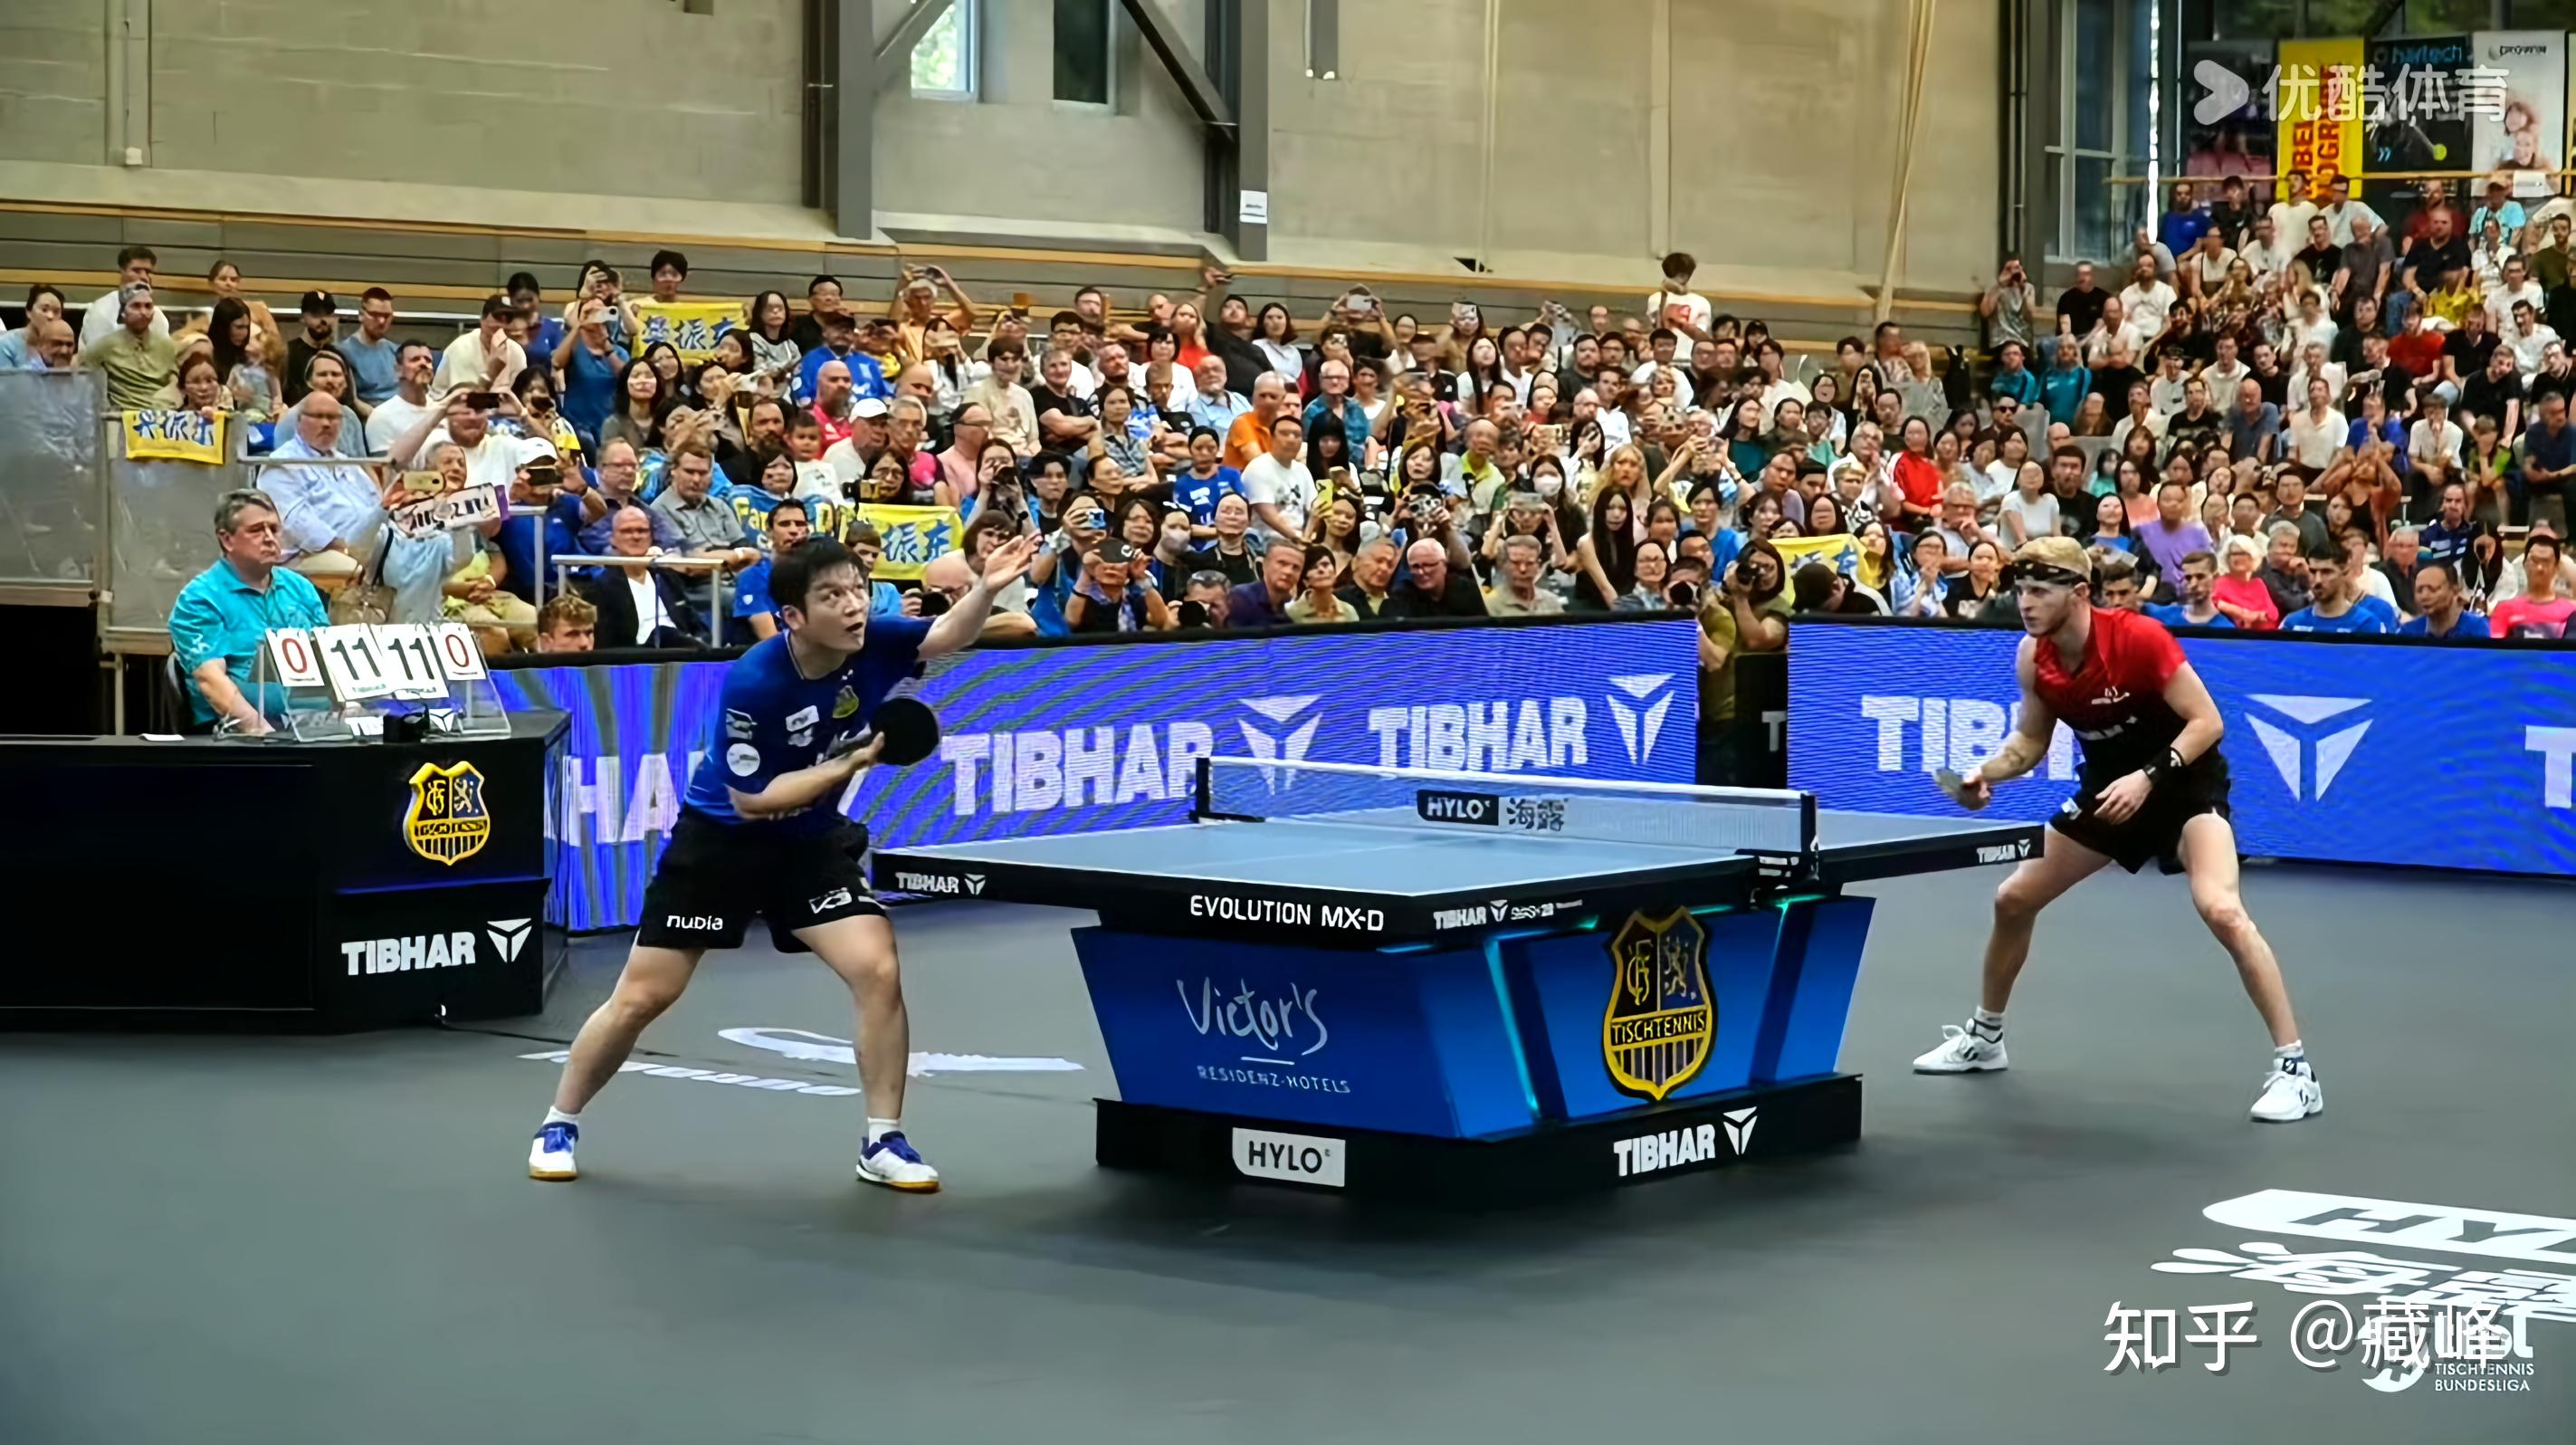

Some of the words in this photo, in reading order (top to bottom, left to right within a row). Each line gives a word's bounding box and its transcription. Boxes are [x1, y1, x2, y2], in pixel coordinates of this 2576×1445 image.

[281, 637, 308, 674] 0
[329, 636, 382, 680] 11
[387, 636, 435, 680] 11
[445, 634, 470, 668] 0
[1369, 696, 1589, 770] TIBHAR
[940, 722, 1215, 816] TIBHAR
[1426, 795, 1485, 820] HYLO
[894, 871, 959, 895] TIBHAR
[1190, 895, 1312, 926] EVOLUTION
[1321, 907, 1385, 932] MX-D
[341, 932, 476, 976] TIBHAR
[1177, 976, 1329, 1057] Victor's
[1611, 1013, 1705, 1044] TISCHTENNIS
[1248, 1140, 1323, 1174] HYLO
[1613, 1124, 1716, 1178] TIBHAR
